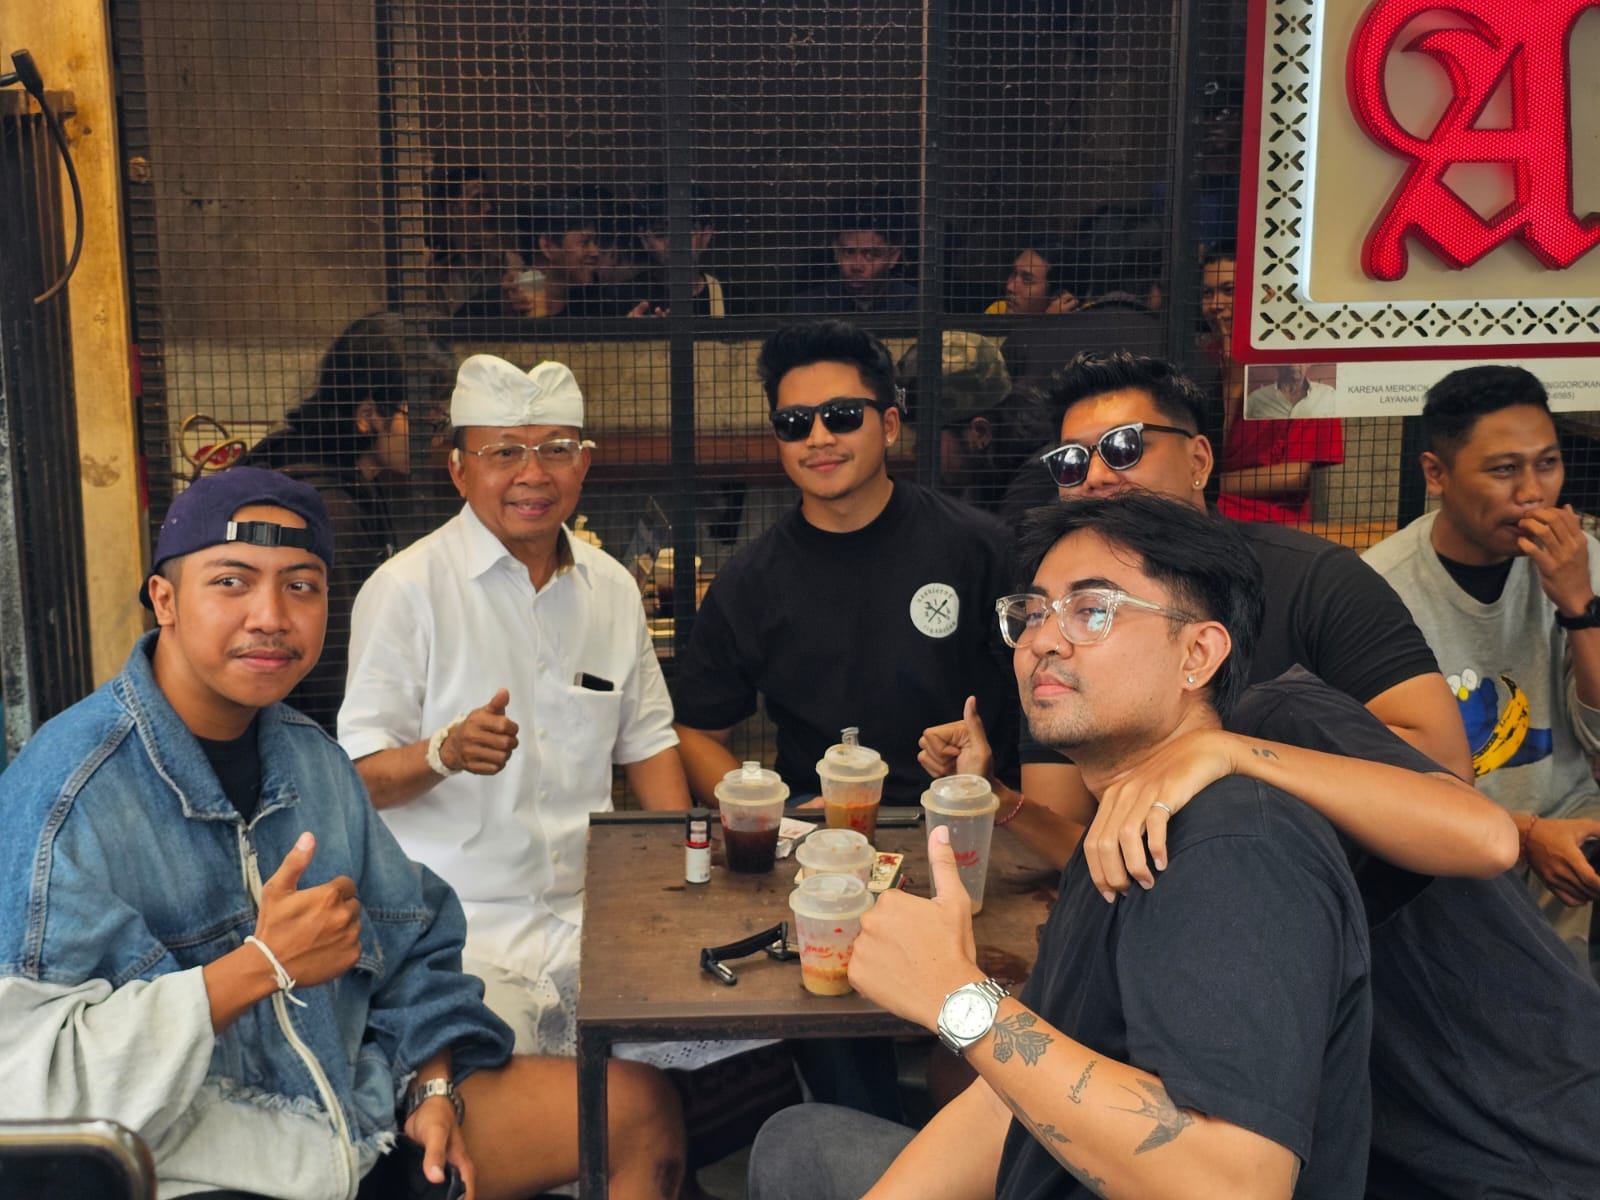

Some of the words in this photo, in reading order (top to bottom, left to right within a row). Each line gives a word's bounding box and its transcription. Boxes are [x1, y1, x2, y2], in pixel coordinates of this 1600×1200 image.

[1347, 386, 1384, 394] KARENA
[1386, 383, 1429, 393] MEROKOK
[1379, 395, 1420, 403] LAYANAN
